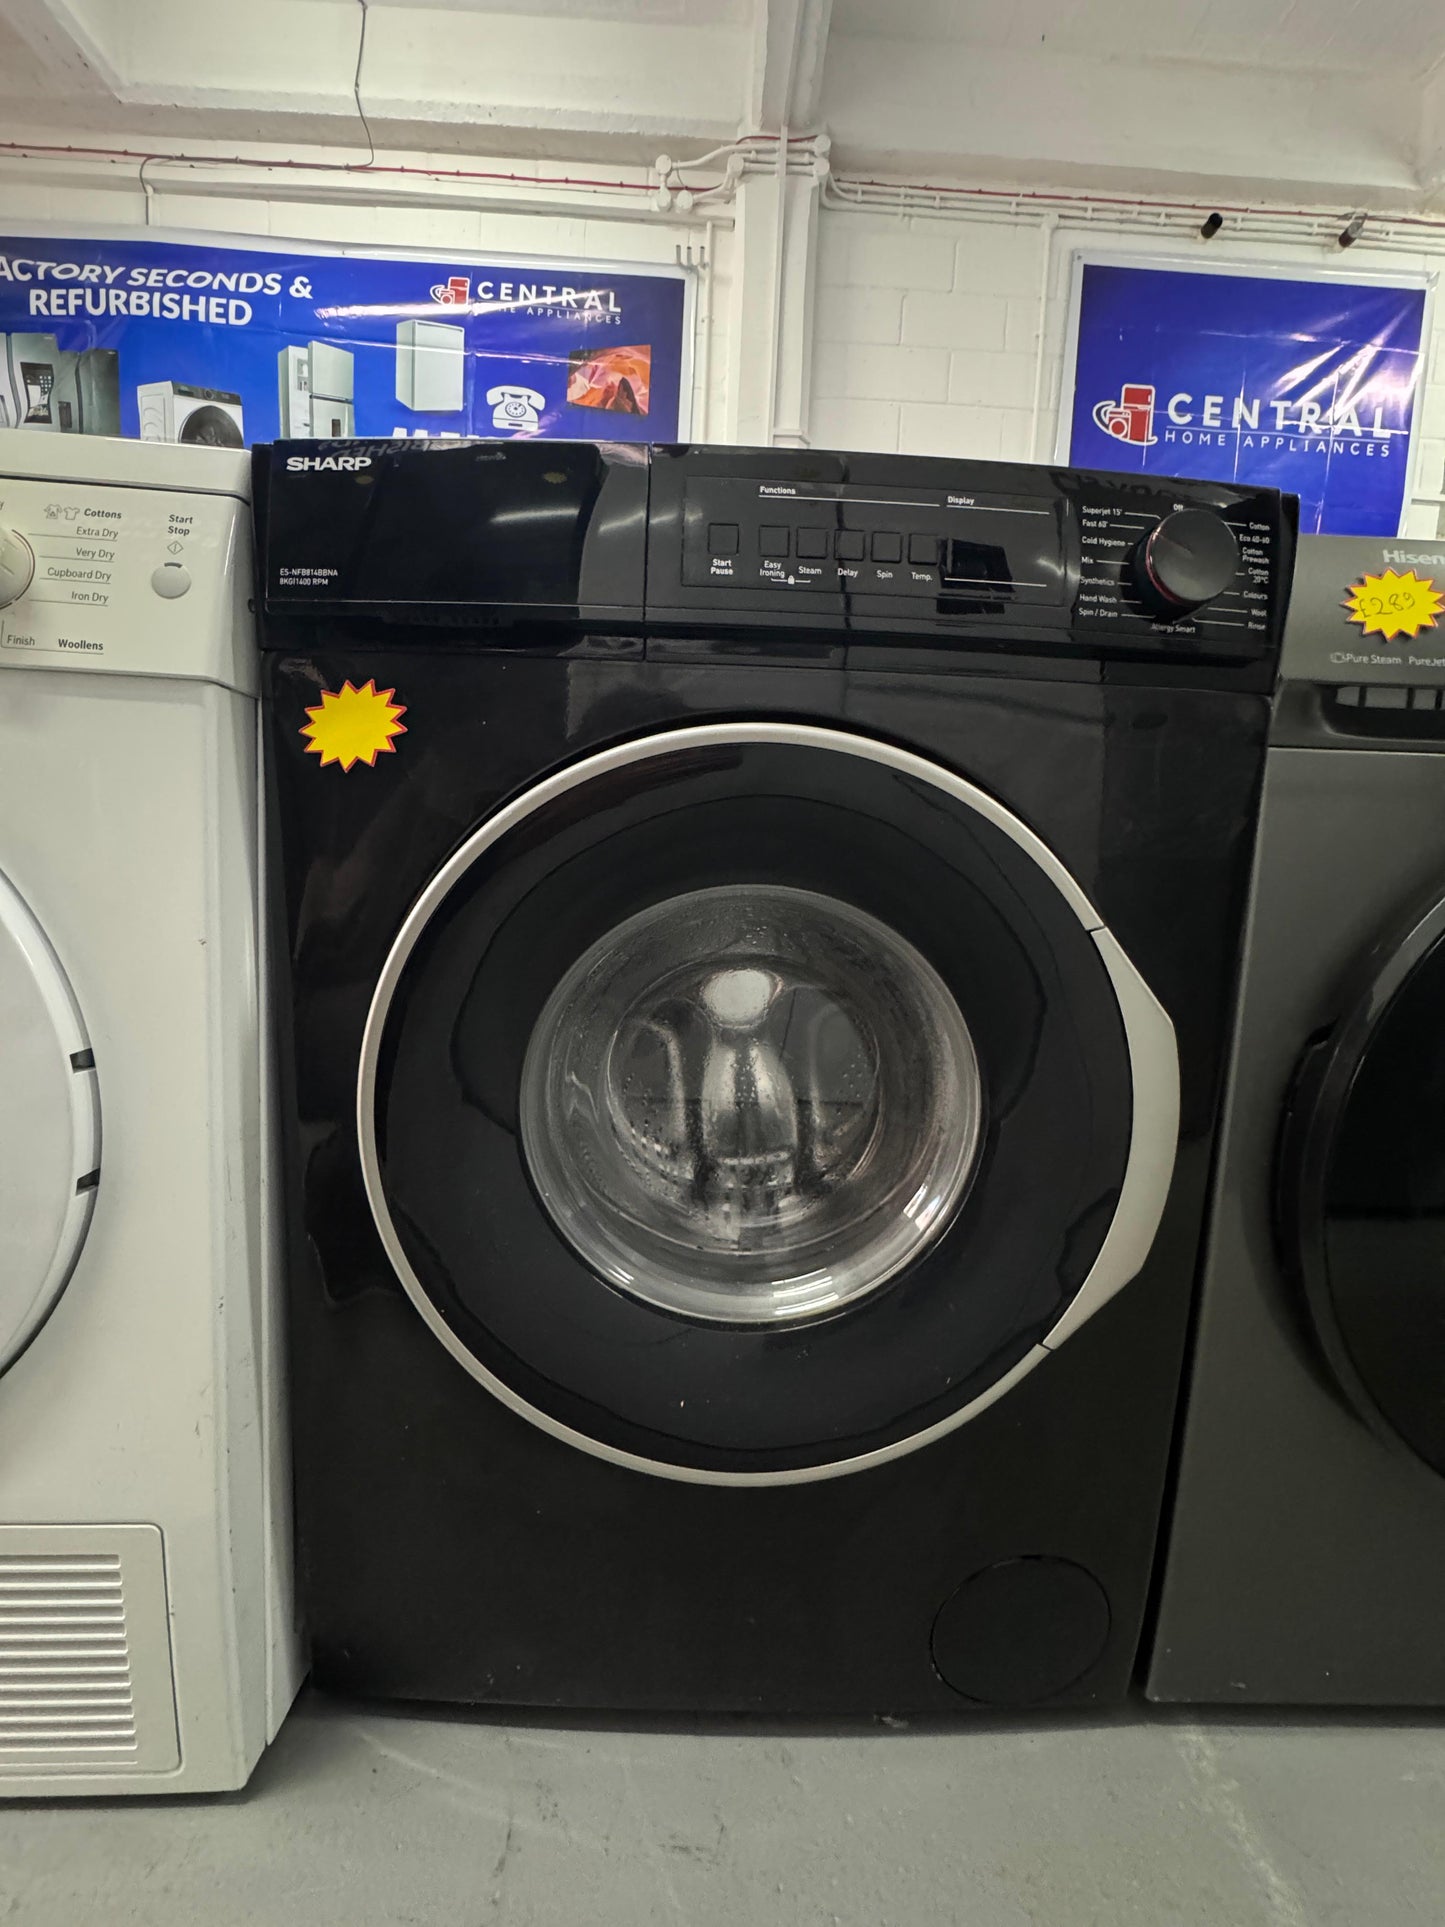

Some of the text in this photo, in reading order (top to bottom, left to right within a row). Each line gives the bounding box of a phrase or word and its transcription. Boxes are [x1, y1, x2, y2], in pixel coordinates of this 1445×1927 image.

[0, 255, 313, 299] ACTORY SECONDS &
[477, 281, 622, 313] CENTRAL
[29, 287, 252, 326] REFURBISHED
[526, 306, 622, 325] APPLIANCES
[1167, 392, 1391, 439] CENTRAL
[1165, 430, 1390, 457] HOME APPLIANCES
[286, 456, 372, 471] SHARP
[760, 486, 796, 495] Functions
[947, 495, 975, 506] Display
[84, 508, 122, 519] Cottons
[1082, 505, 1111, 516] Superjet
[169, 514, 193, 525] Start
[1082, 519, 1097, 528] Fast
[168, 525, 190, 536] Stop
[1249, 522, 1270, 531] Cotton
[76, 526, 118, 540] Extra Dry
[1081, 536, 1098, 545] Cold
[76, 547, 115, 561] Very Dry
[712, 558, 732, 567] Start
[764, 560, 782, 570] Easy
[1081, 556, 1094, 564] Mix
[47, 567, 112, 582] Cupboard Dry
[710, 566, 734, 576] Pause
[760, 568, 785, 579] Ironing
[798, 566, 822, 575] Steam
[837, 568, 858, 578] Delay
[877, 569, 893, 579] Spin
[312, 578, 329, 586] RPM
[911, 572, 933, 582] Temp.
[71, 591, 109, 605] Iron Dry
[1359, 592, 1416, 618] £289
[7, 635, 104, 651] Finish Woollens
[1346, 653, 1369, 663] Pure
[1370, 654, 1402, 664] Steam
